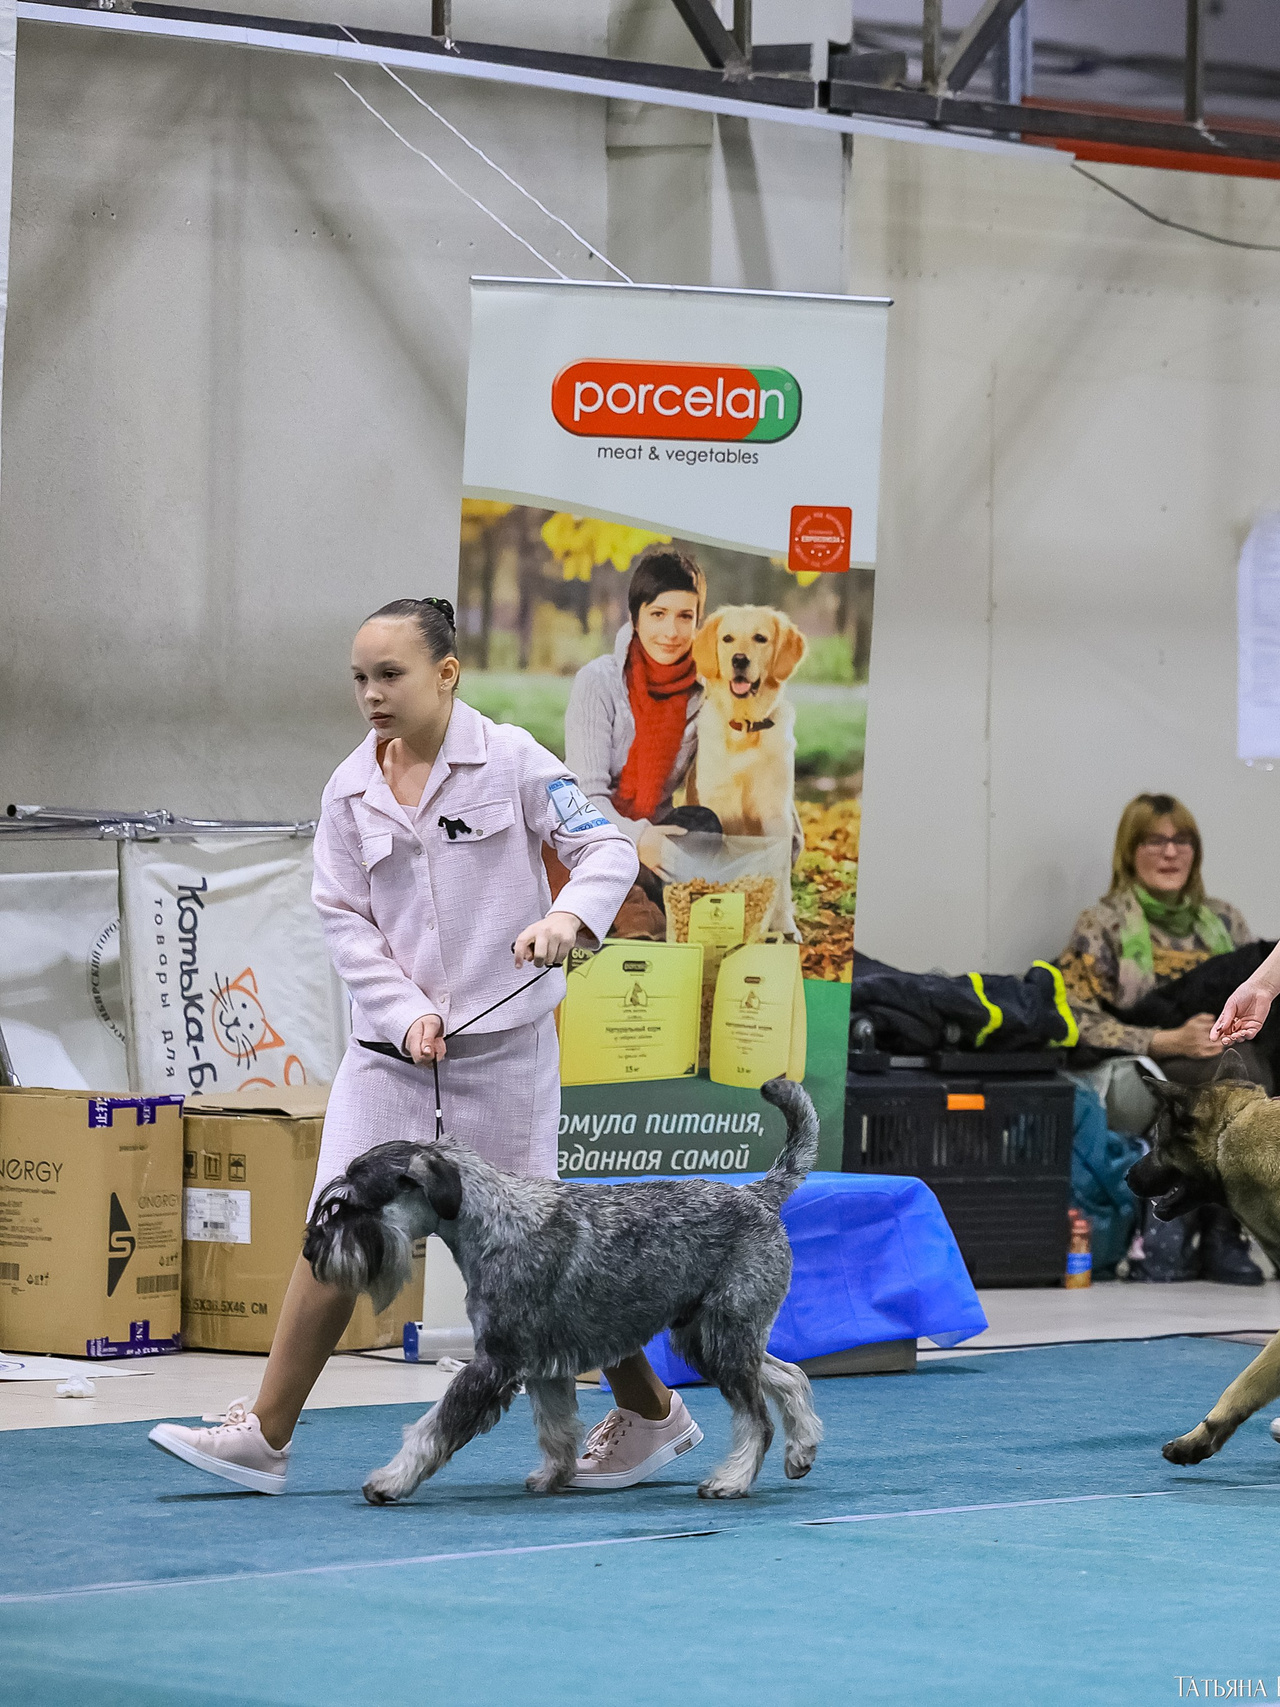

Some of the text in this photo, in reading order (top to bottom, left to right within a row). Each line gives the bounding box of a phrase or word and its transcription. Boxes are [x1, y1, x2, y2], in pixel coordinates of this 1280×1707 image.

[573, 377, 785, 422] porcelan
[597, 444, 760, 466] meat & vegetables
[176, 876, 217, 1096] Котька-Б
[161, 1029, 177, 1078] для
[645, 1112, 765, 1137] питания,
[670, 1143, 750, 1170] самой
